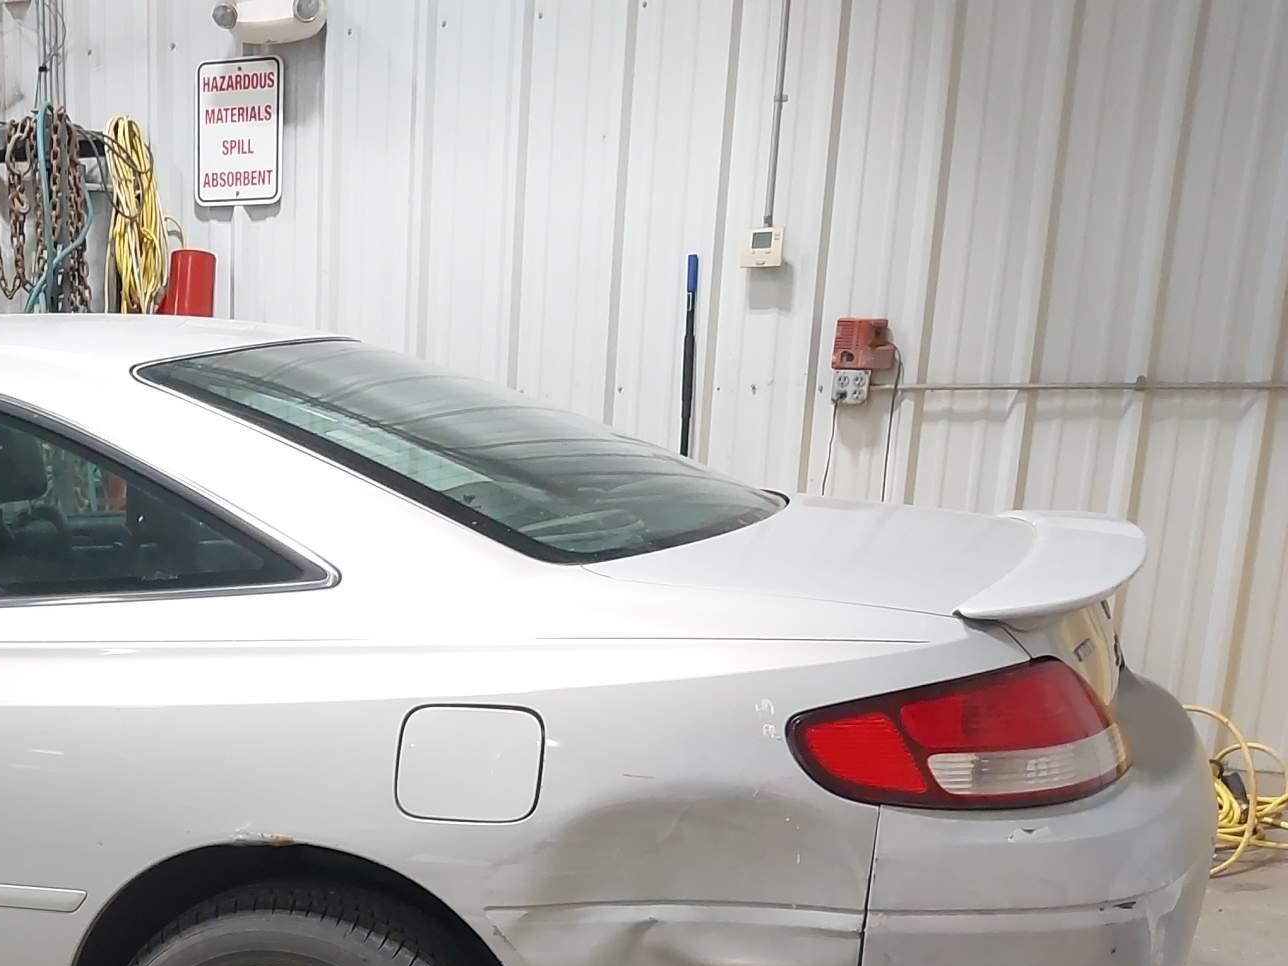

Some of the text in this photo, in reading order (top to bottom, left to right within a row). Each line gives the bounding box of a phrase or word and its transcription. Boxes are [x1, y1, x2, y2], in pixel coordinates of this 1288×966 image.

[202, 72, 275, 93] HAZARDOUS
[204, 104, 272, 125] MATERIALS
[222, 138, 255, 155] SPILL
[203, 169, 273, 188] ABSORBENT
